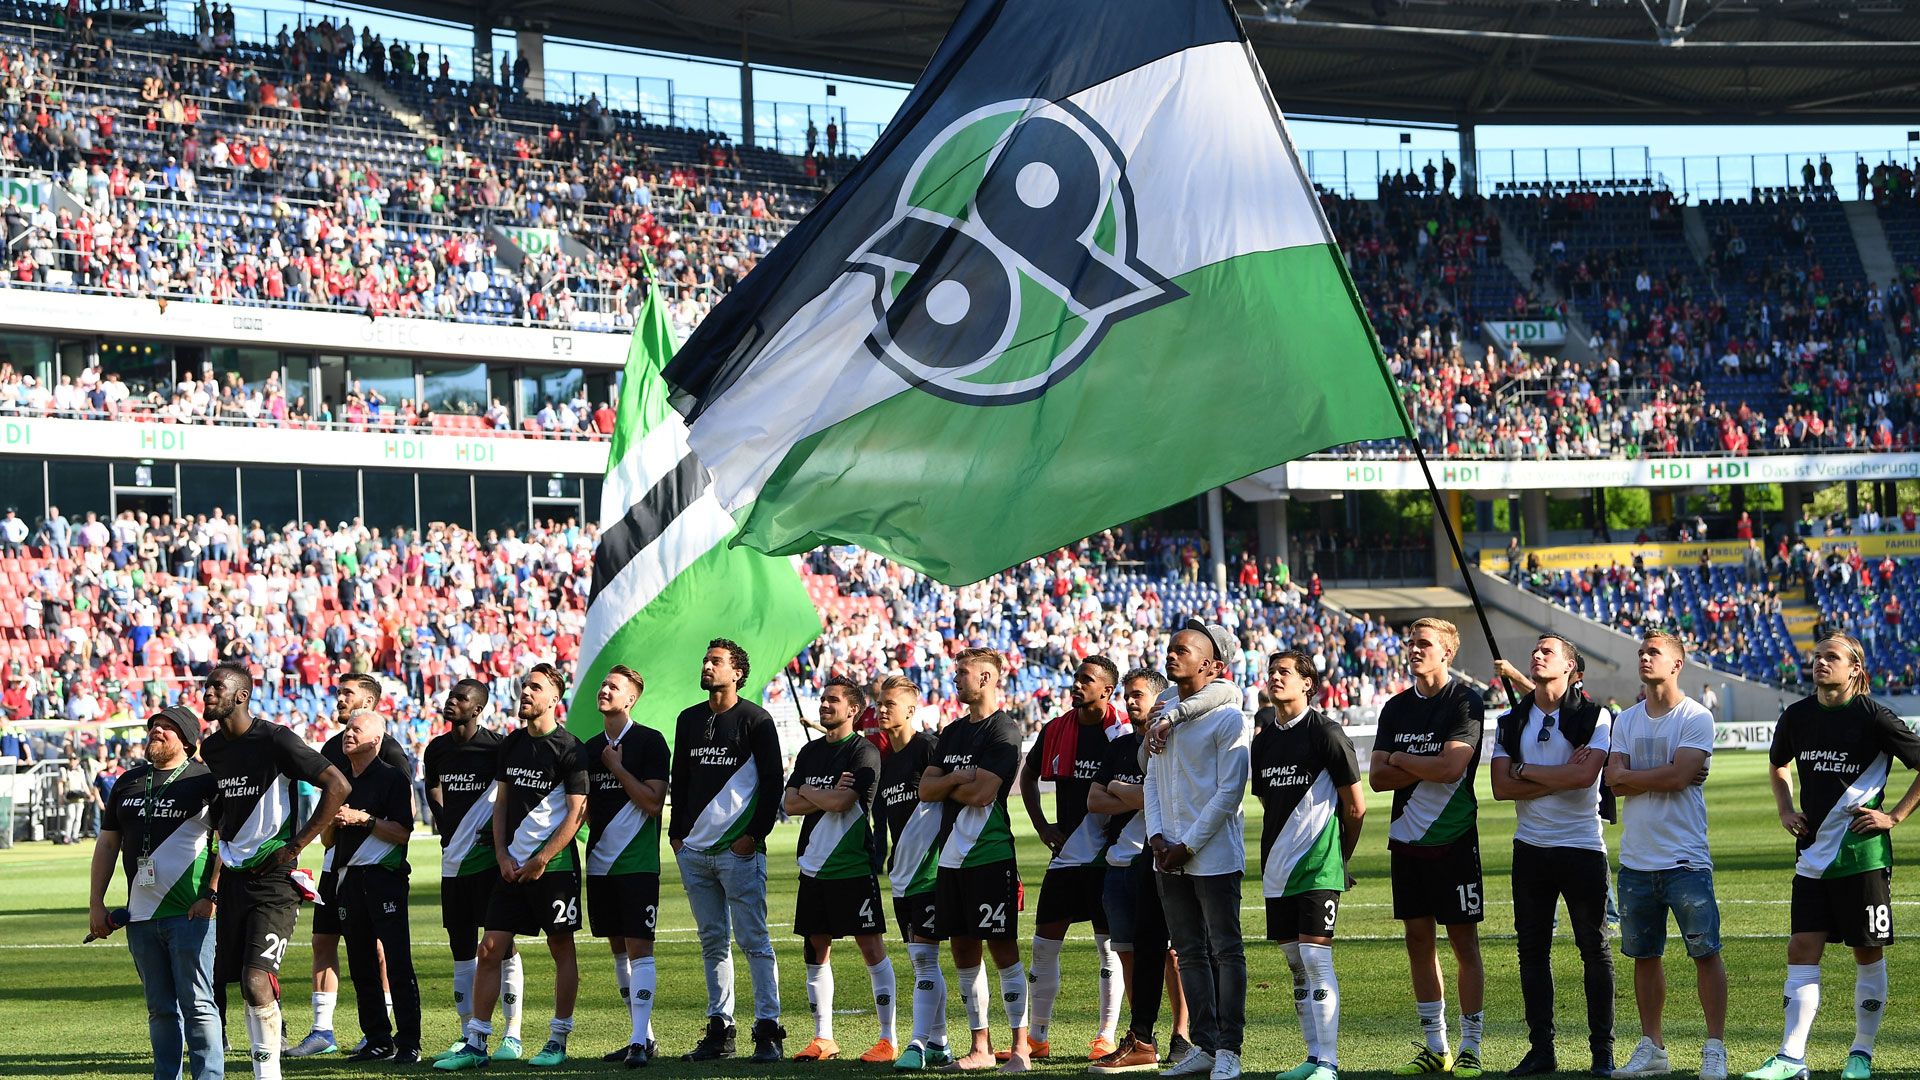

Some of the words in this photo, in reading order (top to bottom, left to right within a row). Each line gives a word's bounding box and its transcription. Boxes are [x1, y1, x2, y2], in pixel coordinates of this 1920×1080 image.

[0, 182, 39, 207] DI
[1505, 324, 1545, 339] HDI
[0, 424, 30, 444] DI
[141, 430, 185, 450] HDI
[384, 440, 424, 459] HDI
[456, 443, 494, 462] HDI
[1346, 467, 1383, 482] HDI
[1444, 467, 1480, 483] HDI
[1650, 463, 1690, 479] HDI
[1707, 462, 1749, 478] HDI
[1762, 463, 1789, 477] Das
[1794, 461, 1810, 476] ist
[690, 747, 728, 757] NIEMALS
[1800, 750, 1849, 762] NIEMALS
[700, 756, 738, 766] ALLEIN!
[1813, 761, 1861, 774] ALLEIN!
[506, 767, 543, 779] NIEMALS
[1269, 775, 1309, 787] ALLEIN!
[448, 782, 486, 791] ALLEIN!
[514, 777, 552, 790] ALLEIN!
[225, 786, 259, 798] ALLEIN!
[886, 790, 918, 806] ALLEIN!
[137, 808, 187, 819] ALEIN!
[1456, 883, 1480, 912] 15
[552, 897, 577, 924] 26
[645, 905, 659, 928] 3
[858, 899, 874, 922] 4
[922, 905, 936, 928] 2
[978, 902, 1006, 928] 24
[1865, 904, 1890, 933] 18
[260, 933, 288, 964] 20
